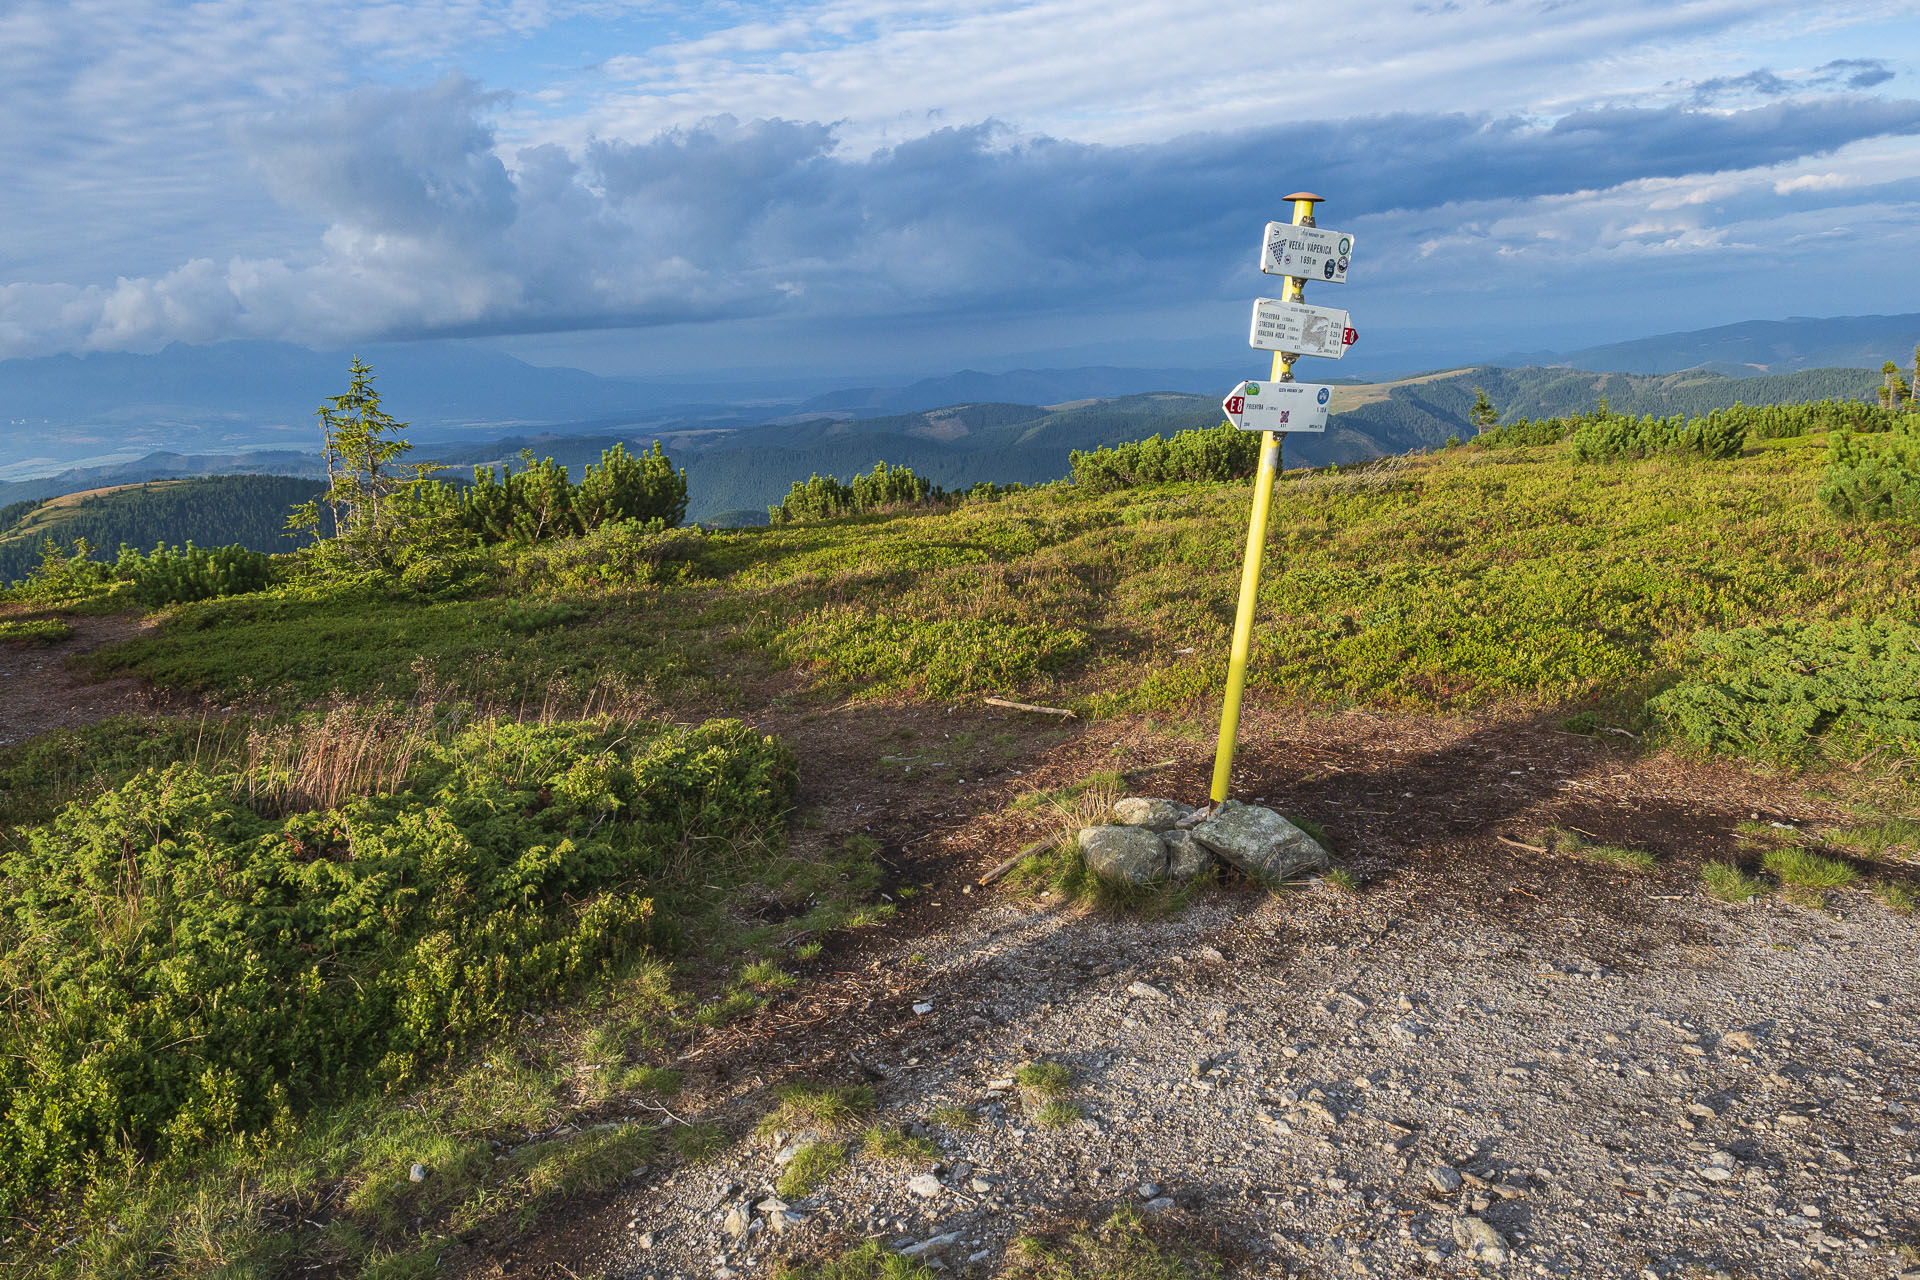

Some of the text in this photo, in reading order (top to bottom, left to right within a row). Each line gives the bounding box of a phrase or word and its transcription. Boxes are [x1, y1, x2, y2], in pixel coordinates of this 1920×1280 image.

[1307, 242, 1332, 255] VÁPENICA
[1343, 330, 1354, 344] E 8
[1230, 398, 1243, 412] E 8
